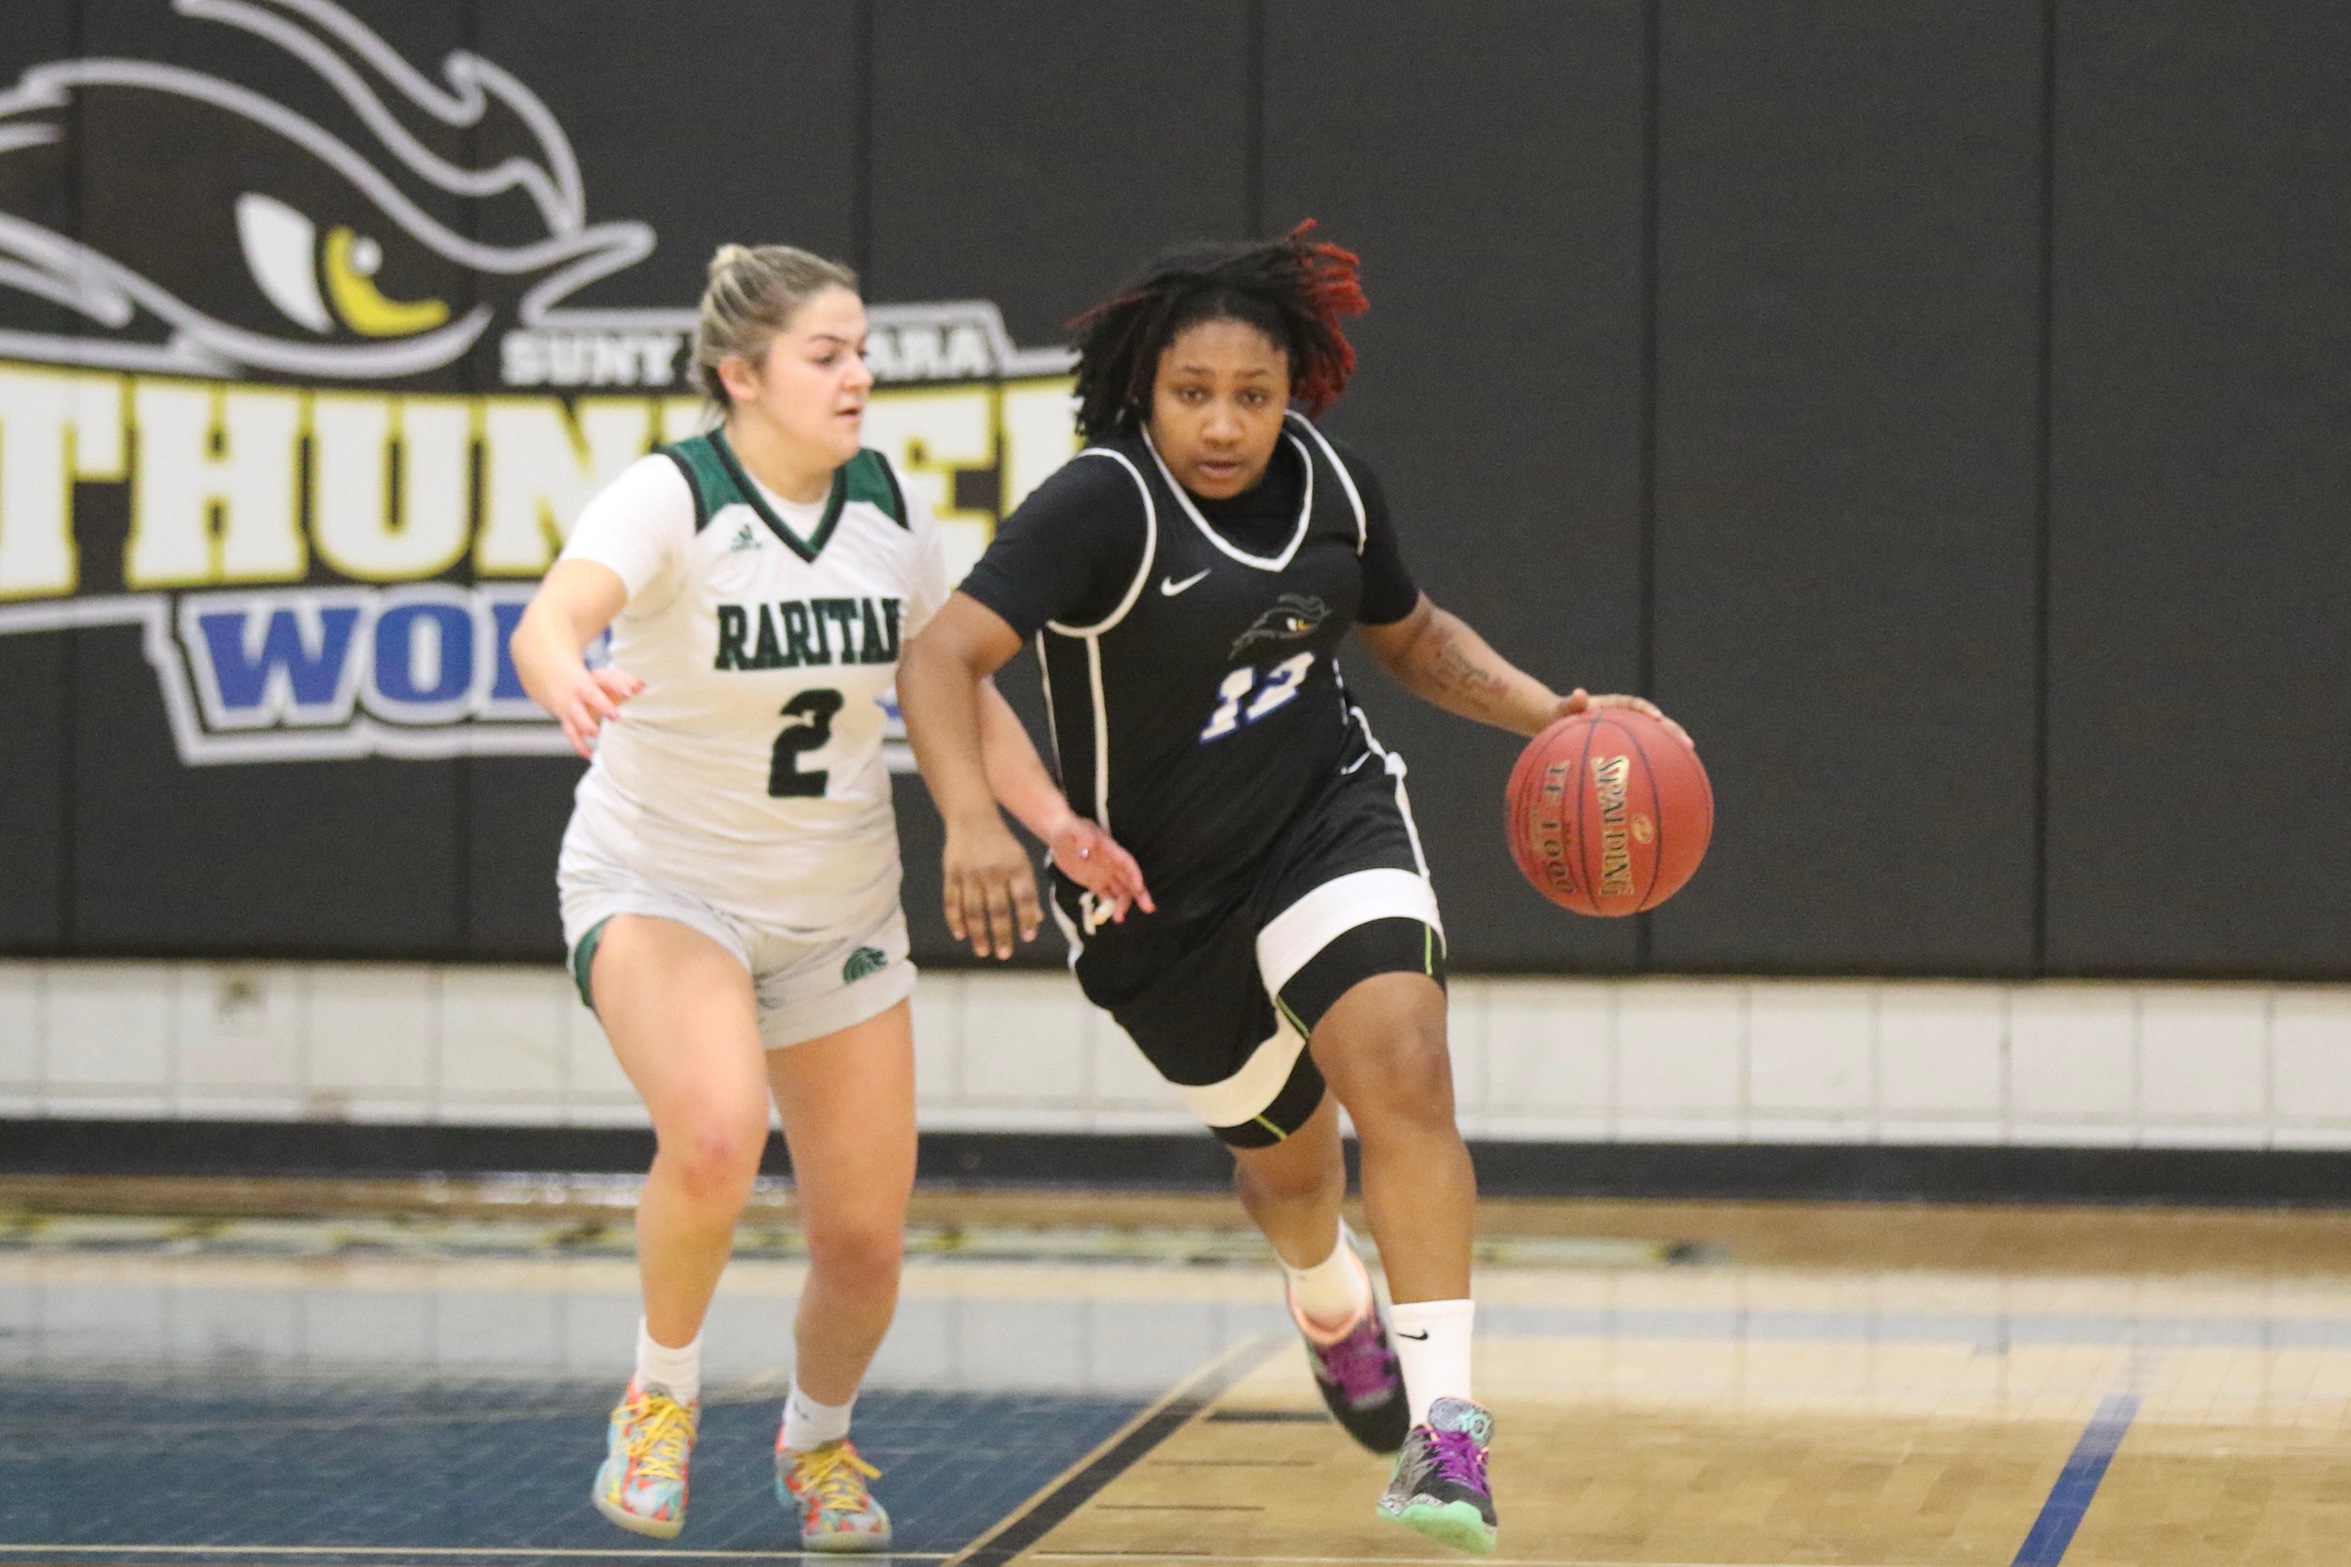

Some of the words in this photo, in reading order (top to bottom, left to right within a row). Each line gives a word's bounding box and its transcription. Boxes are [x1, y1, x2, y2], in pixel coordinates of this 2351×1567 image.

[501, 328, 682, 385] SUNY
[0, 362, 1086, 602] THUNE
[768, 687, 844, 797] 2
[1199, 651, 1317, 744] 12
[1591, 755, 1633, 895] SPALDING
